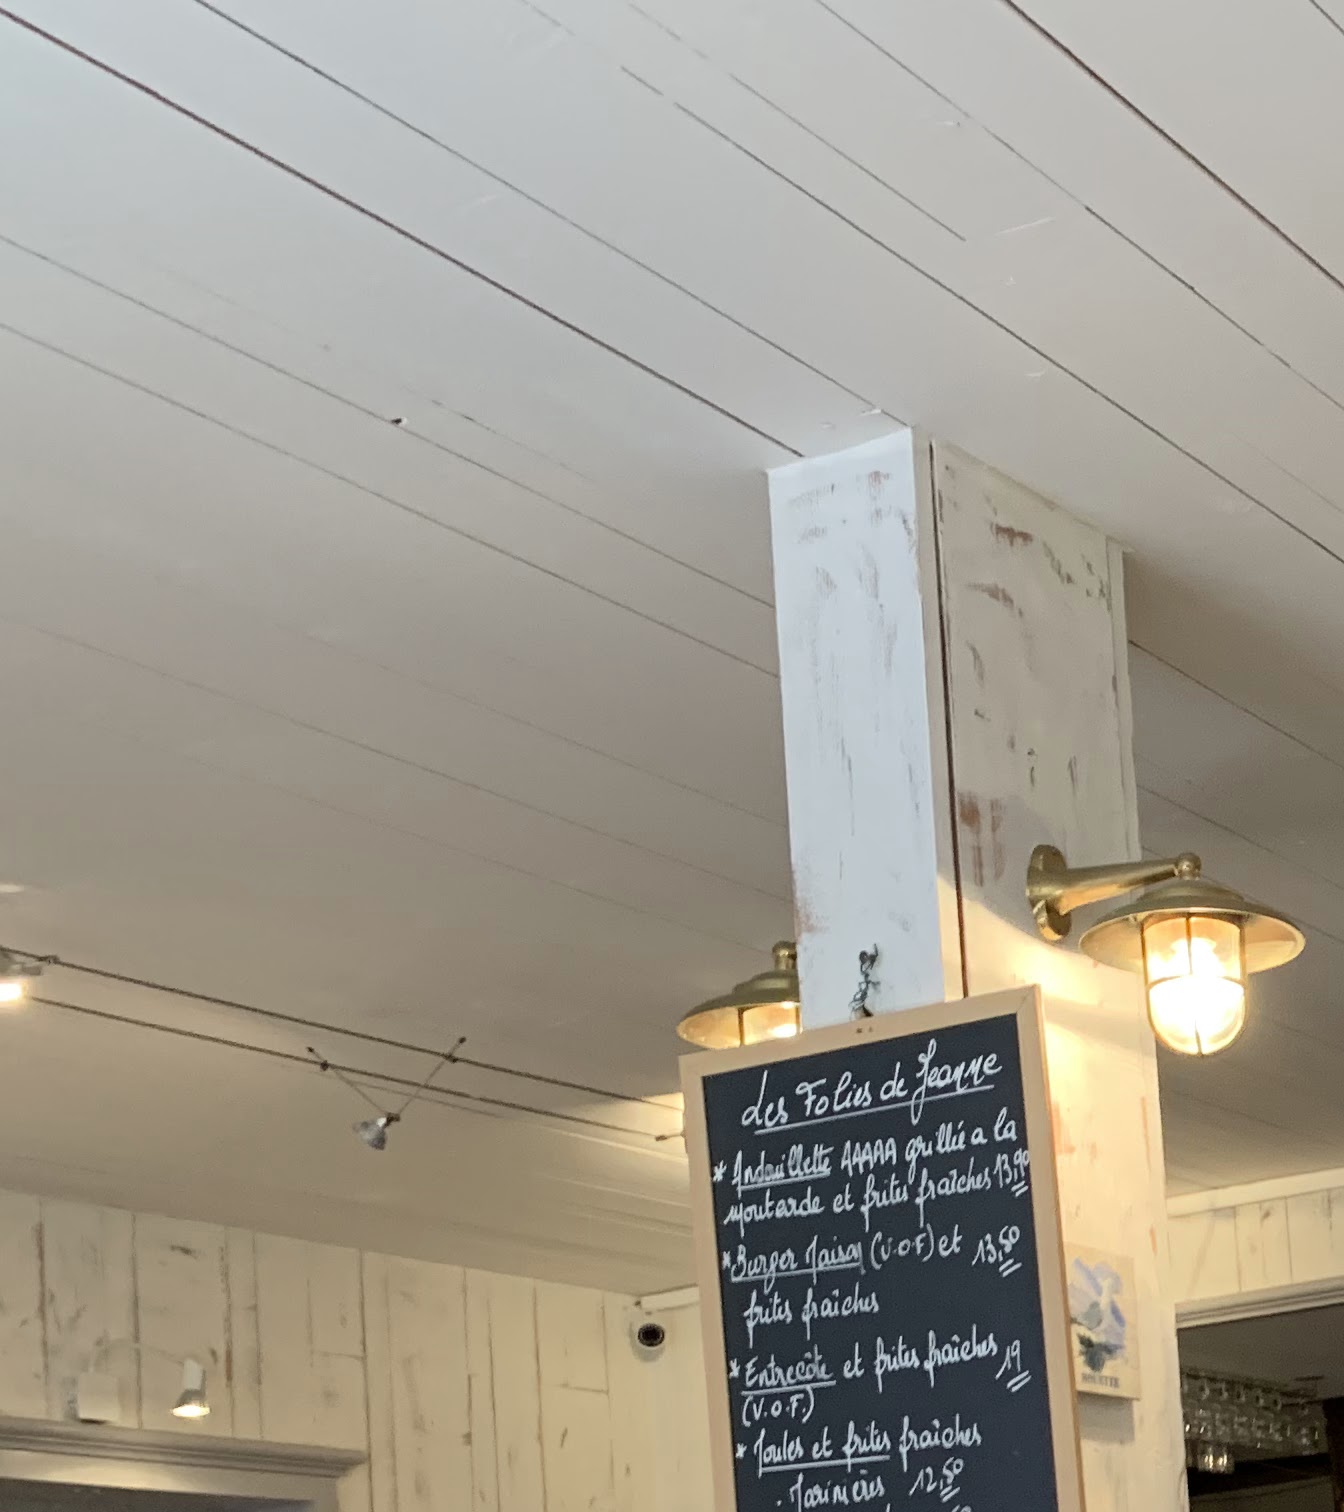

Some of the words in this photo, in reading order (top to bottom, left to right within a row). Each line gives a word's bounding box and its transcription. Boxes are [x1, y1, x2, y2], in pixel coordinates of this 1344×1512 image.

[741, 1070, 788, 1126] Les
[795, 1071, 872, 1118] Folies
[879, 1061, 908, 1100] de
[910, 1038, 1003, 1125] Jeanne
[731, 1143, 834, 1198] Andouillette
[840, 1137, 897, 1177] AAAAA
[993, 1106, 1018, 1142] la
[832, 1187, 855, 1214] et
[860, 1172, 909, 1233] frites
[730, 1243, 799, 1295] Burger
[938, 1223, 963, 1257] et
[971, 1225, 1021, 1267] 13,50
[743, 1288, 793, 1349] frites
[801, 1281, 880, 1341] fraîches
[744, 1343, 836, 1388] Entrecôte
[842, 1341, 865, 1380] et
[874, 1335, 920, 1394] frites
[923, 1323, 998, 1389] fraîches
[995, 1339, 1022, 1381] 19
[753, 1427, 805, 1479] Moules
[811, 1425, 833, 1460] et
[842, 1420, 892, 1473] frites
[898, 1413, 983, 1473] fraîches
[908, 1456, 965, 1497] 12,50
